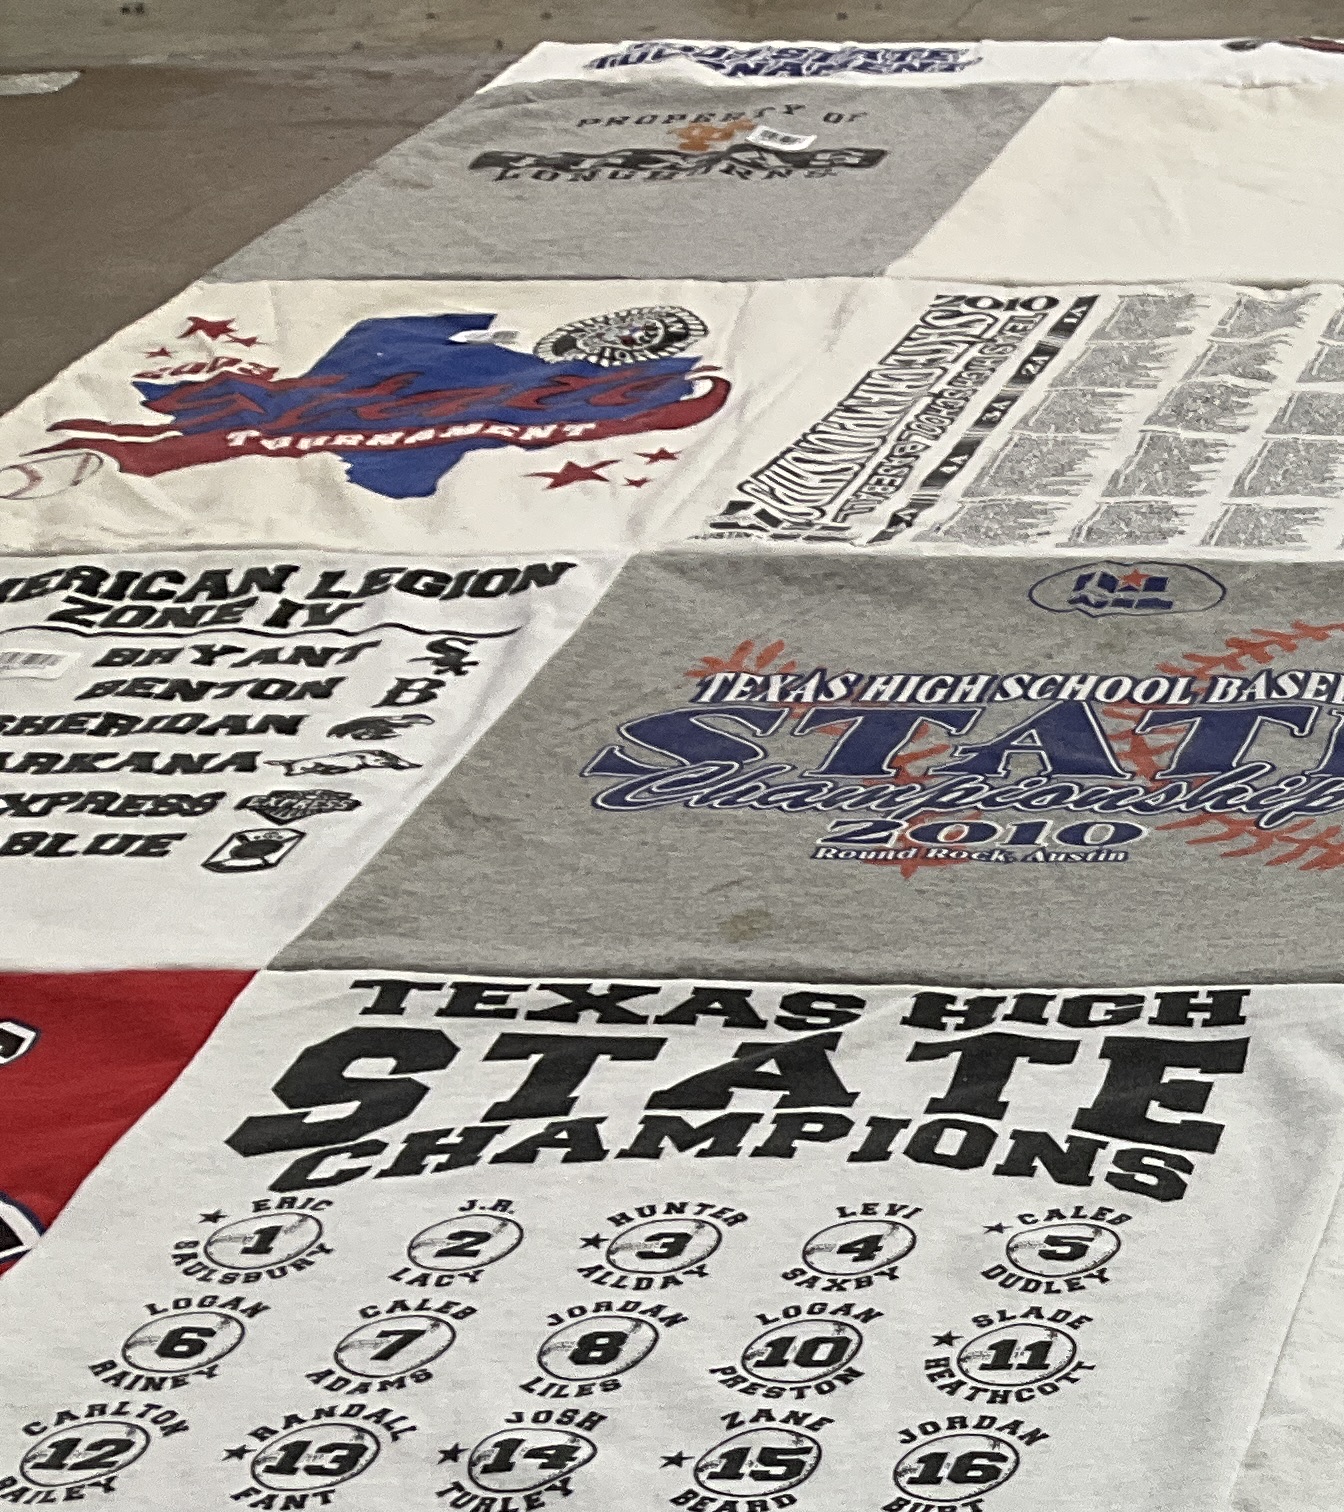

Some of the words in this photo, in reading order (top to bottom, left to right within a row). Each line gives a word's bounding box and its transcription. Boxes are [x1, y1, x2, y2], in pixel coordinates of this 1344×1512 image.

[931, 294, 1060, 311] 2010
[225, 421, 598, 452] TOURNAMENT
[305, 562, 577, 600] LEGION
[47, 596, 258, 629] ZONE
[263, 599, 366, 628] IV
[91, 639, 382, 668] BRYANT
[74, 677, 346, 702] BENTON
[694, 670, 860, 703] TEXAS
[868, 672, 999, 704] HIGH
[997, 673, 1197, 706] SCHOOL
[2, 832, 188, 857] BLUE
[815, 820, 1152, 849] 2010
[811, 847, 917, 862] Round
[1019, 847, 1131, 864] Austin
[350, 979, 866, 1031] TEXAS
[900, 989, 1251, 1031] HIGH
[225, 1026, 1250, 1157] STATE
[268, 1112, 1194, 1201] CHAMPIONS
[252, 1196, 333, 1213] ERIC
[605, 1201, 749, 1228] HUNTER
[240, 1226, 283, 1255] 1
[635, 1232, 693, 1260] 3
[1038, 1235, 1094, 1261] 5
[171, 1240, 334, 1285] SAULSBURY
[577, 1264, 709, 1290] ALLDAY
[981, 1264, 1110, 1294] DUDLEY
[709, 1366, 865, 1400] PRESTON
[505, 1409, 608, 1431] JOSH
[480, 1438, 581, 1474] 14
[707, 1447, 813, 1481] 15
[230, 1487, 335, 1511] FANT
